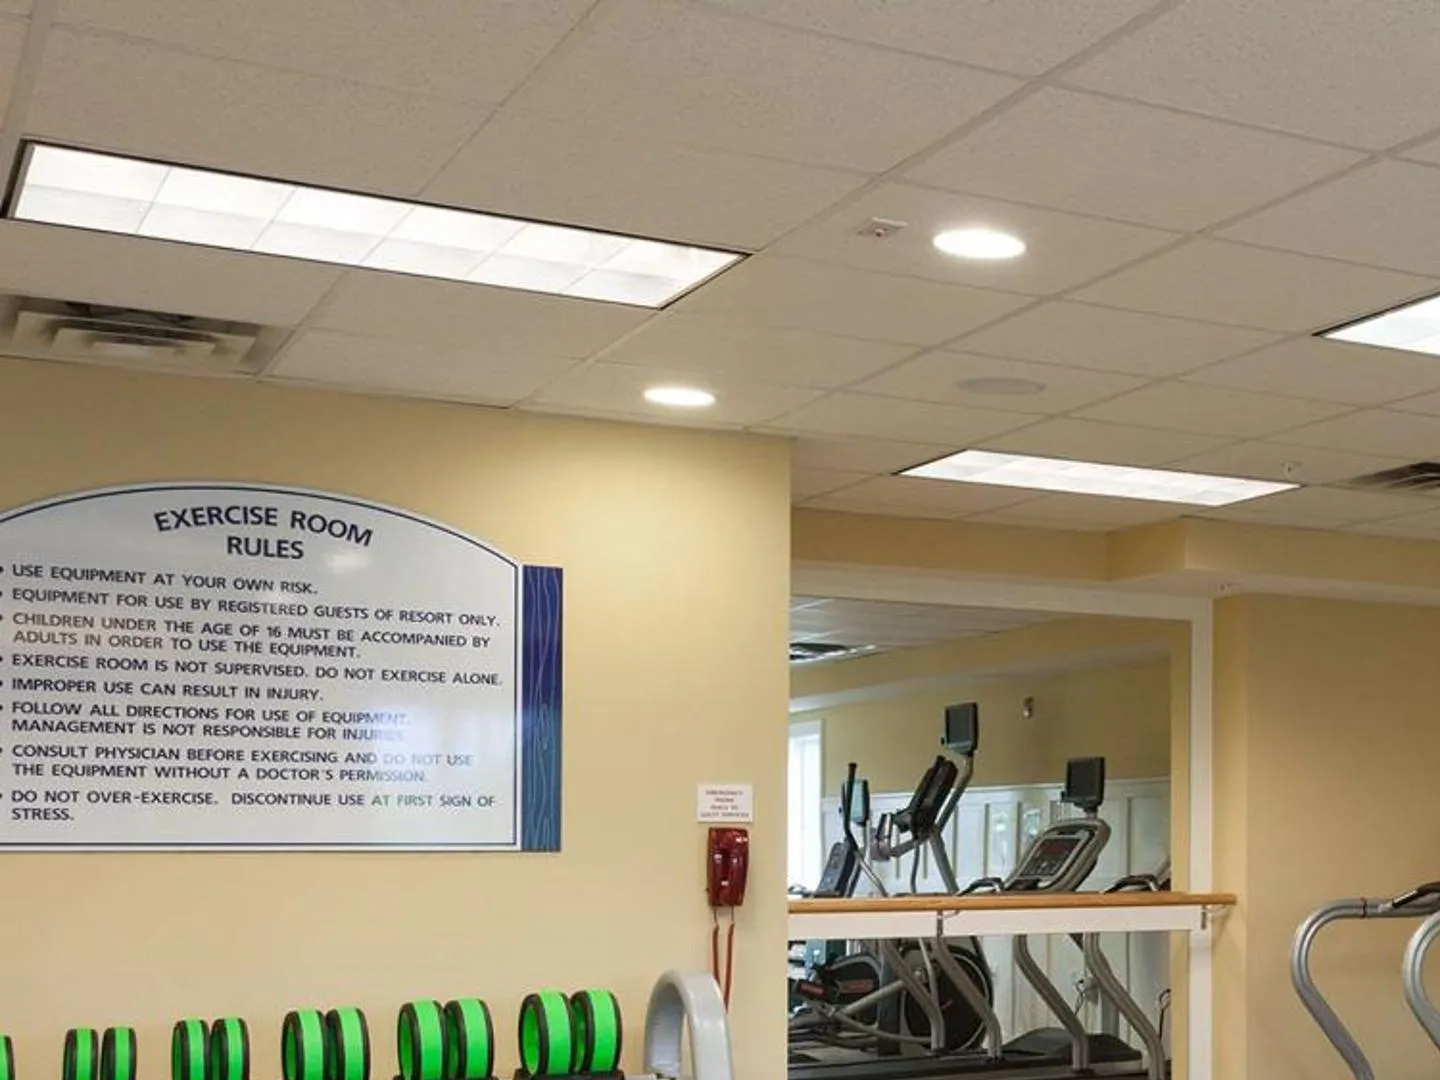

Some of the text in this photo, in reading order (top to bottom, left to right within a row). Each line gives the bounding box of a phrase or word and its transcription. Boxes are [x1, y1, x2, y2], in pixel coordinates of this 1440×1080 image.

[154, 506, 372, 546] EXERCISE ROOM
[228, 536, 304, 559] RULES
[13, 564, 317, 594] USE EQUIPMENT AT YOUR OWN RISK.
[13, 588, 500, 626] EQUIPMENT FOR USE BY REGISTERED GUESTS OF RESORT ONLY.
[13, 612, 490, 647] CHILDREN UNDER THE AGE OF 16 MUST BE ACCOMPANIED BY
[14, 630, 360, 658] ADULTS IN ORDER TO USE THE EQUIPMENT.
[12, 654, 502, 685] EXERCISE ROOM IS NOT SUPERVISED. DO NOT EXERCISE ALONE.
[13, 678, 323, 700] IMPROPER USE CAN RESULT IN INJURY.
[12, 702, 82, 715] FOLLOW
[90, 704, 119, 716] ALL
[126, 705, 218, 719] DIRECTIONS
[226, 708, 255, 720] FOR
[262, 710, 288, 722] USE
[296, 711, 314, 722] OF
[12, 720, 404, 741] MANAGEMENT IS NOT RESPONSIBLE FOR INJU
[12, 745, 474, 766] CONSULT PHYSICIAN BEFORE EXERCISING AND DO NOT USE
[12, 764, 44, 776] THE
[52, 764, 147, 778] EQUIPMENT
[155, 766, 230, 779] WITHOUT
[238, 768, 249, 779] A
[12, 790, 37, 802] DO
[45, 791, 80, 803] NOT
[232, 793, 330, 805] DISCONTINUE
[338, 794, 364, 805] USE
[372, 795, 390, 806] AT
[397, 795, 432, 806] FIRST
[440, 795, 471, 806] SIGN
[477, 796, 496, 806] OF
[12, 808, 74, 820] STRESS.
